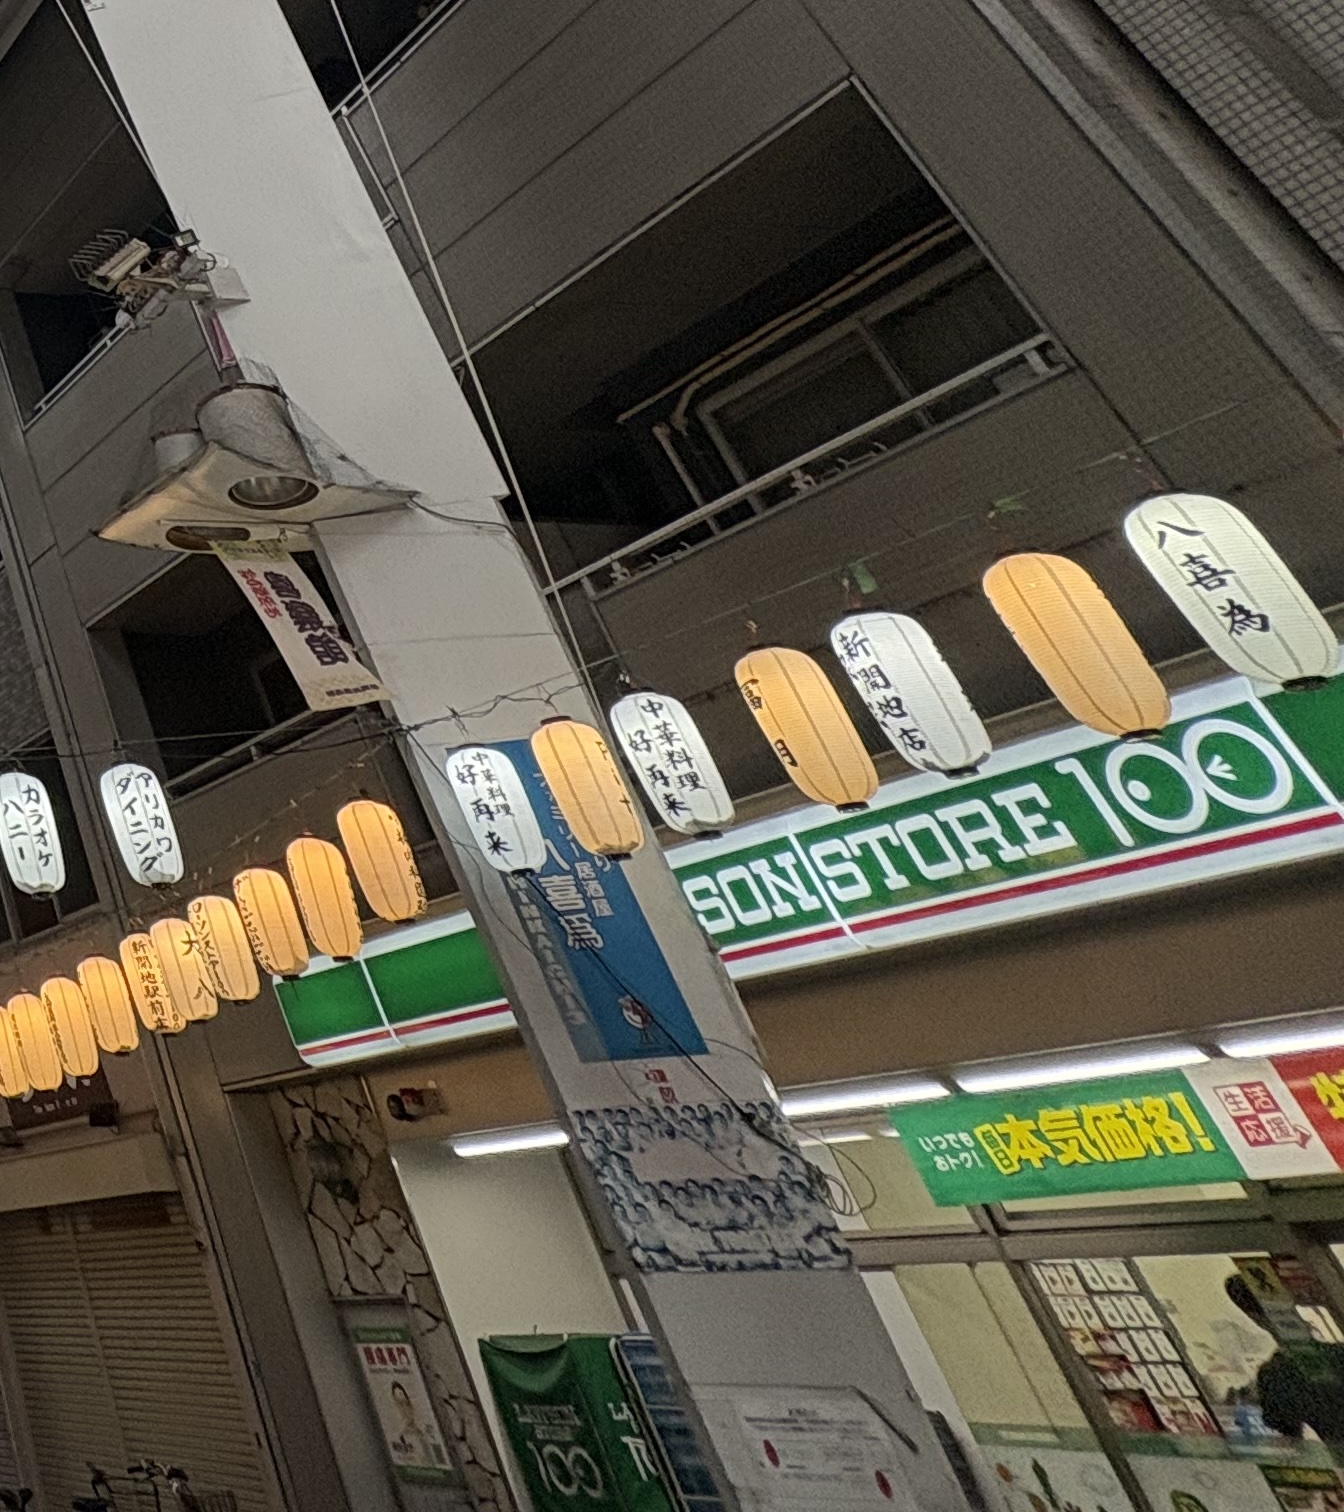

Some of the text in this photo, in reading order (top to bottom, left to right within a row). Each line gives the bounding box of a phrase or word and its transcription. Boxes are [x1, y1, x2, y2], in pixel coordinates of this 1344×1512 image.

[469, 750, 516, 819] 中華料理
[627, 728, 692, 819] 好再来
[639, 697, 708, 792] 中華料理
[2, 798, 30, 862] ハニー
[21, 783, 54, 868] カラオケ
[114, 770, 165, 873] ダイニング
[135, 771, 174, 854] アリカワ
[812, 782, 1076, 905] STORE
[1053, 717, 1294, 848] 100
[919, 1130, 975, 1154] いつでも
